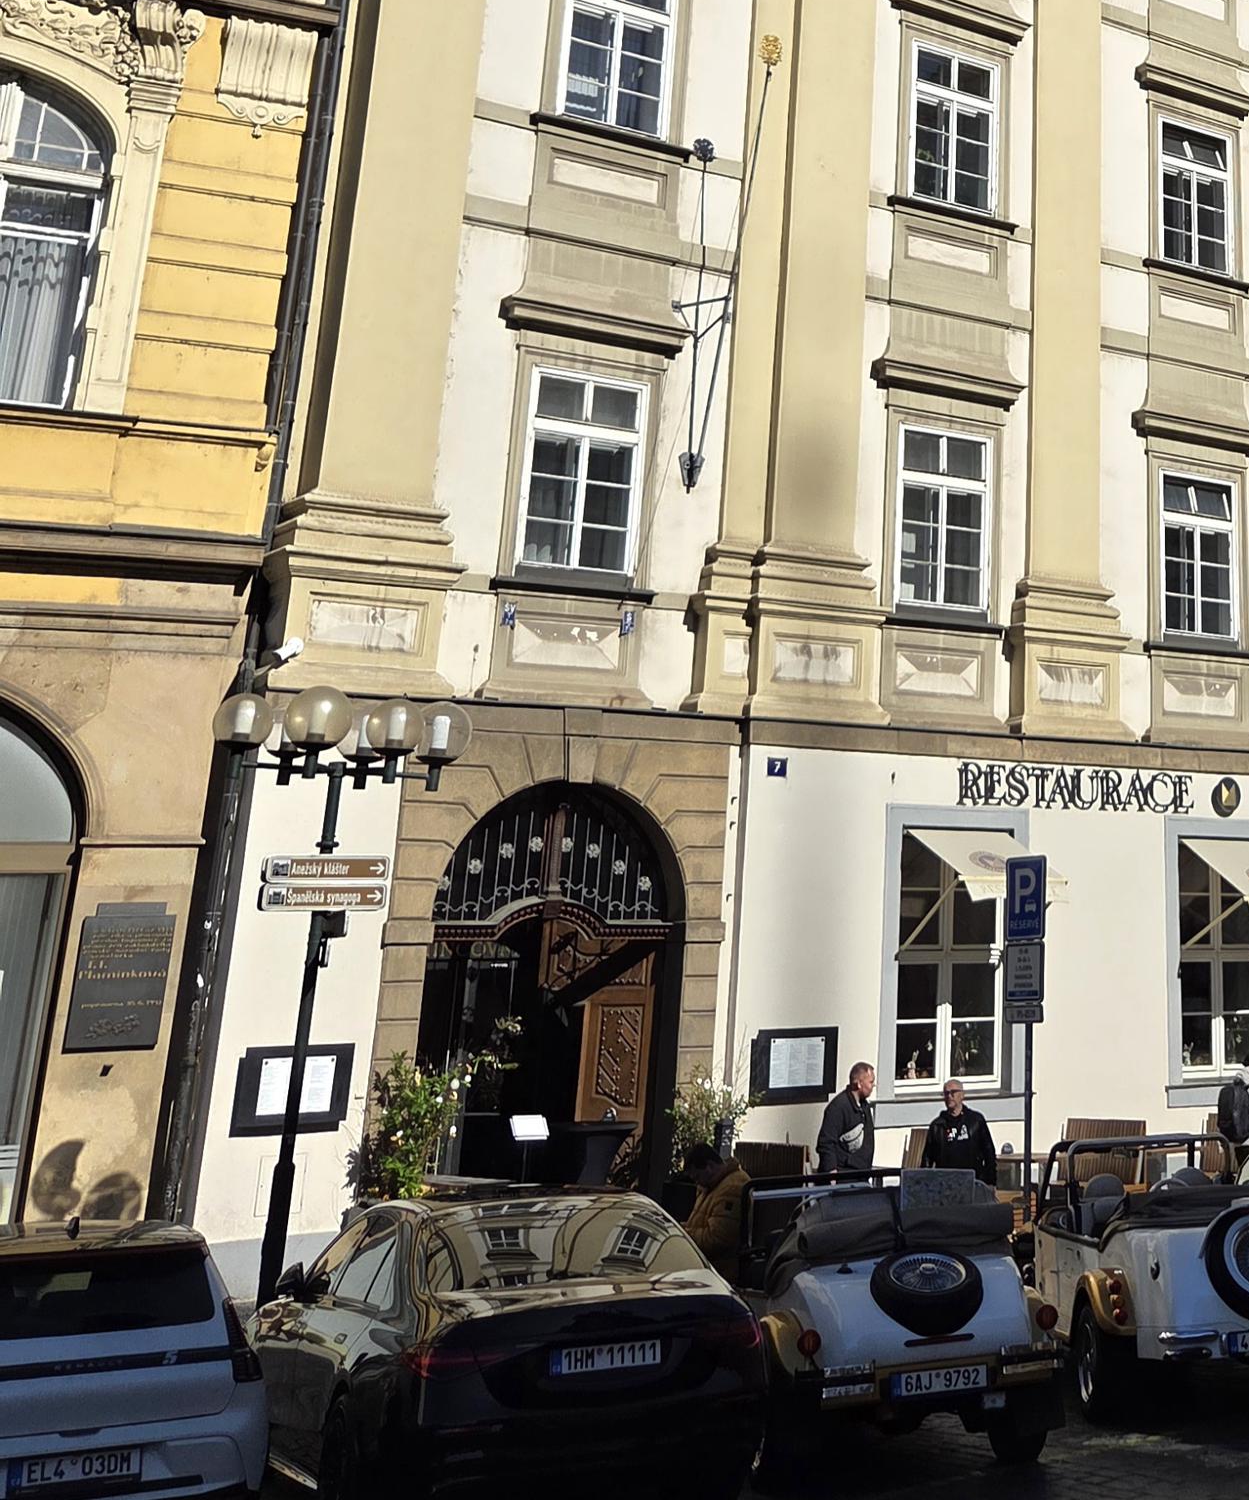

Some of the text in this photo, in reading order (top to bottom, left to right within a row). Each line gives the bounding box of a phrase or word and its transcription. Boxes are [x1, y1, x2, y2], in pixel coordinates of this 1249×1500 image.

[774, 761, 781, 773] 7
[957, 761, 1195, 814] RESTAURACE
[291, 862, 350, 877] Anežský klášter
[287, 888, 361, 906] Španělská synagoga
[1015, 868, 1036, 914] P
[565, 1342, 656, 1371] 1HM 11111
[905, 1368, 980, 1392] 6AJ 9792
[27, 1452, 131, 1483] EL4 03DM
